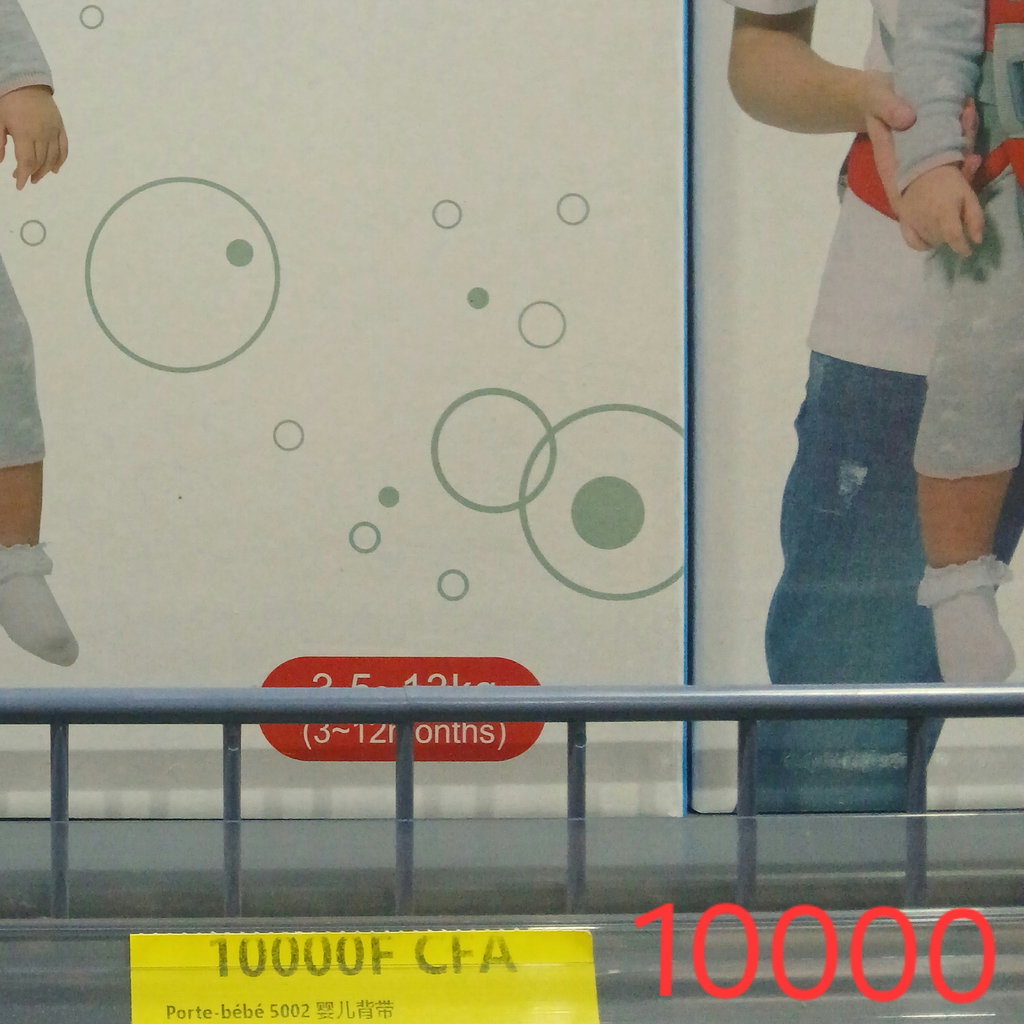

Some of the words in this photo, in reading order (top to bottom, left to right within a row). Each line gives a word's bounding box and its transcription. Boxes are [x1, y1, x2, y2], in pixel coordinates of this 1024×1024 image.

[210, 935, 394, 978] 10000F
[414, 935, 518, 976] CFA
[166, 1003, 265, 1021] Porte-bébé
[270, 1003, 311, 1019] 5002
[316, 999, 395, 1021] 婴儿背带
